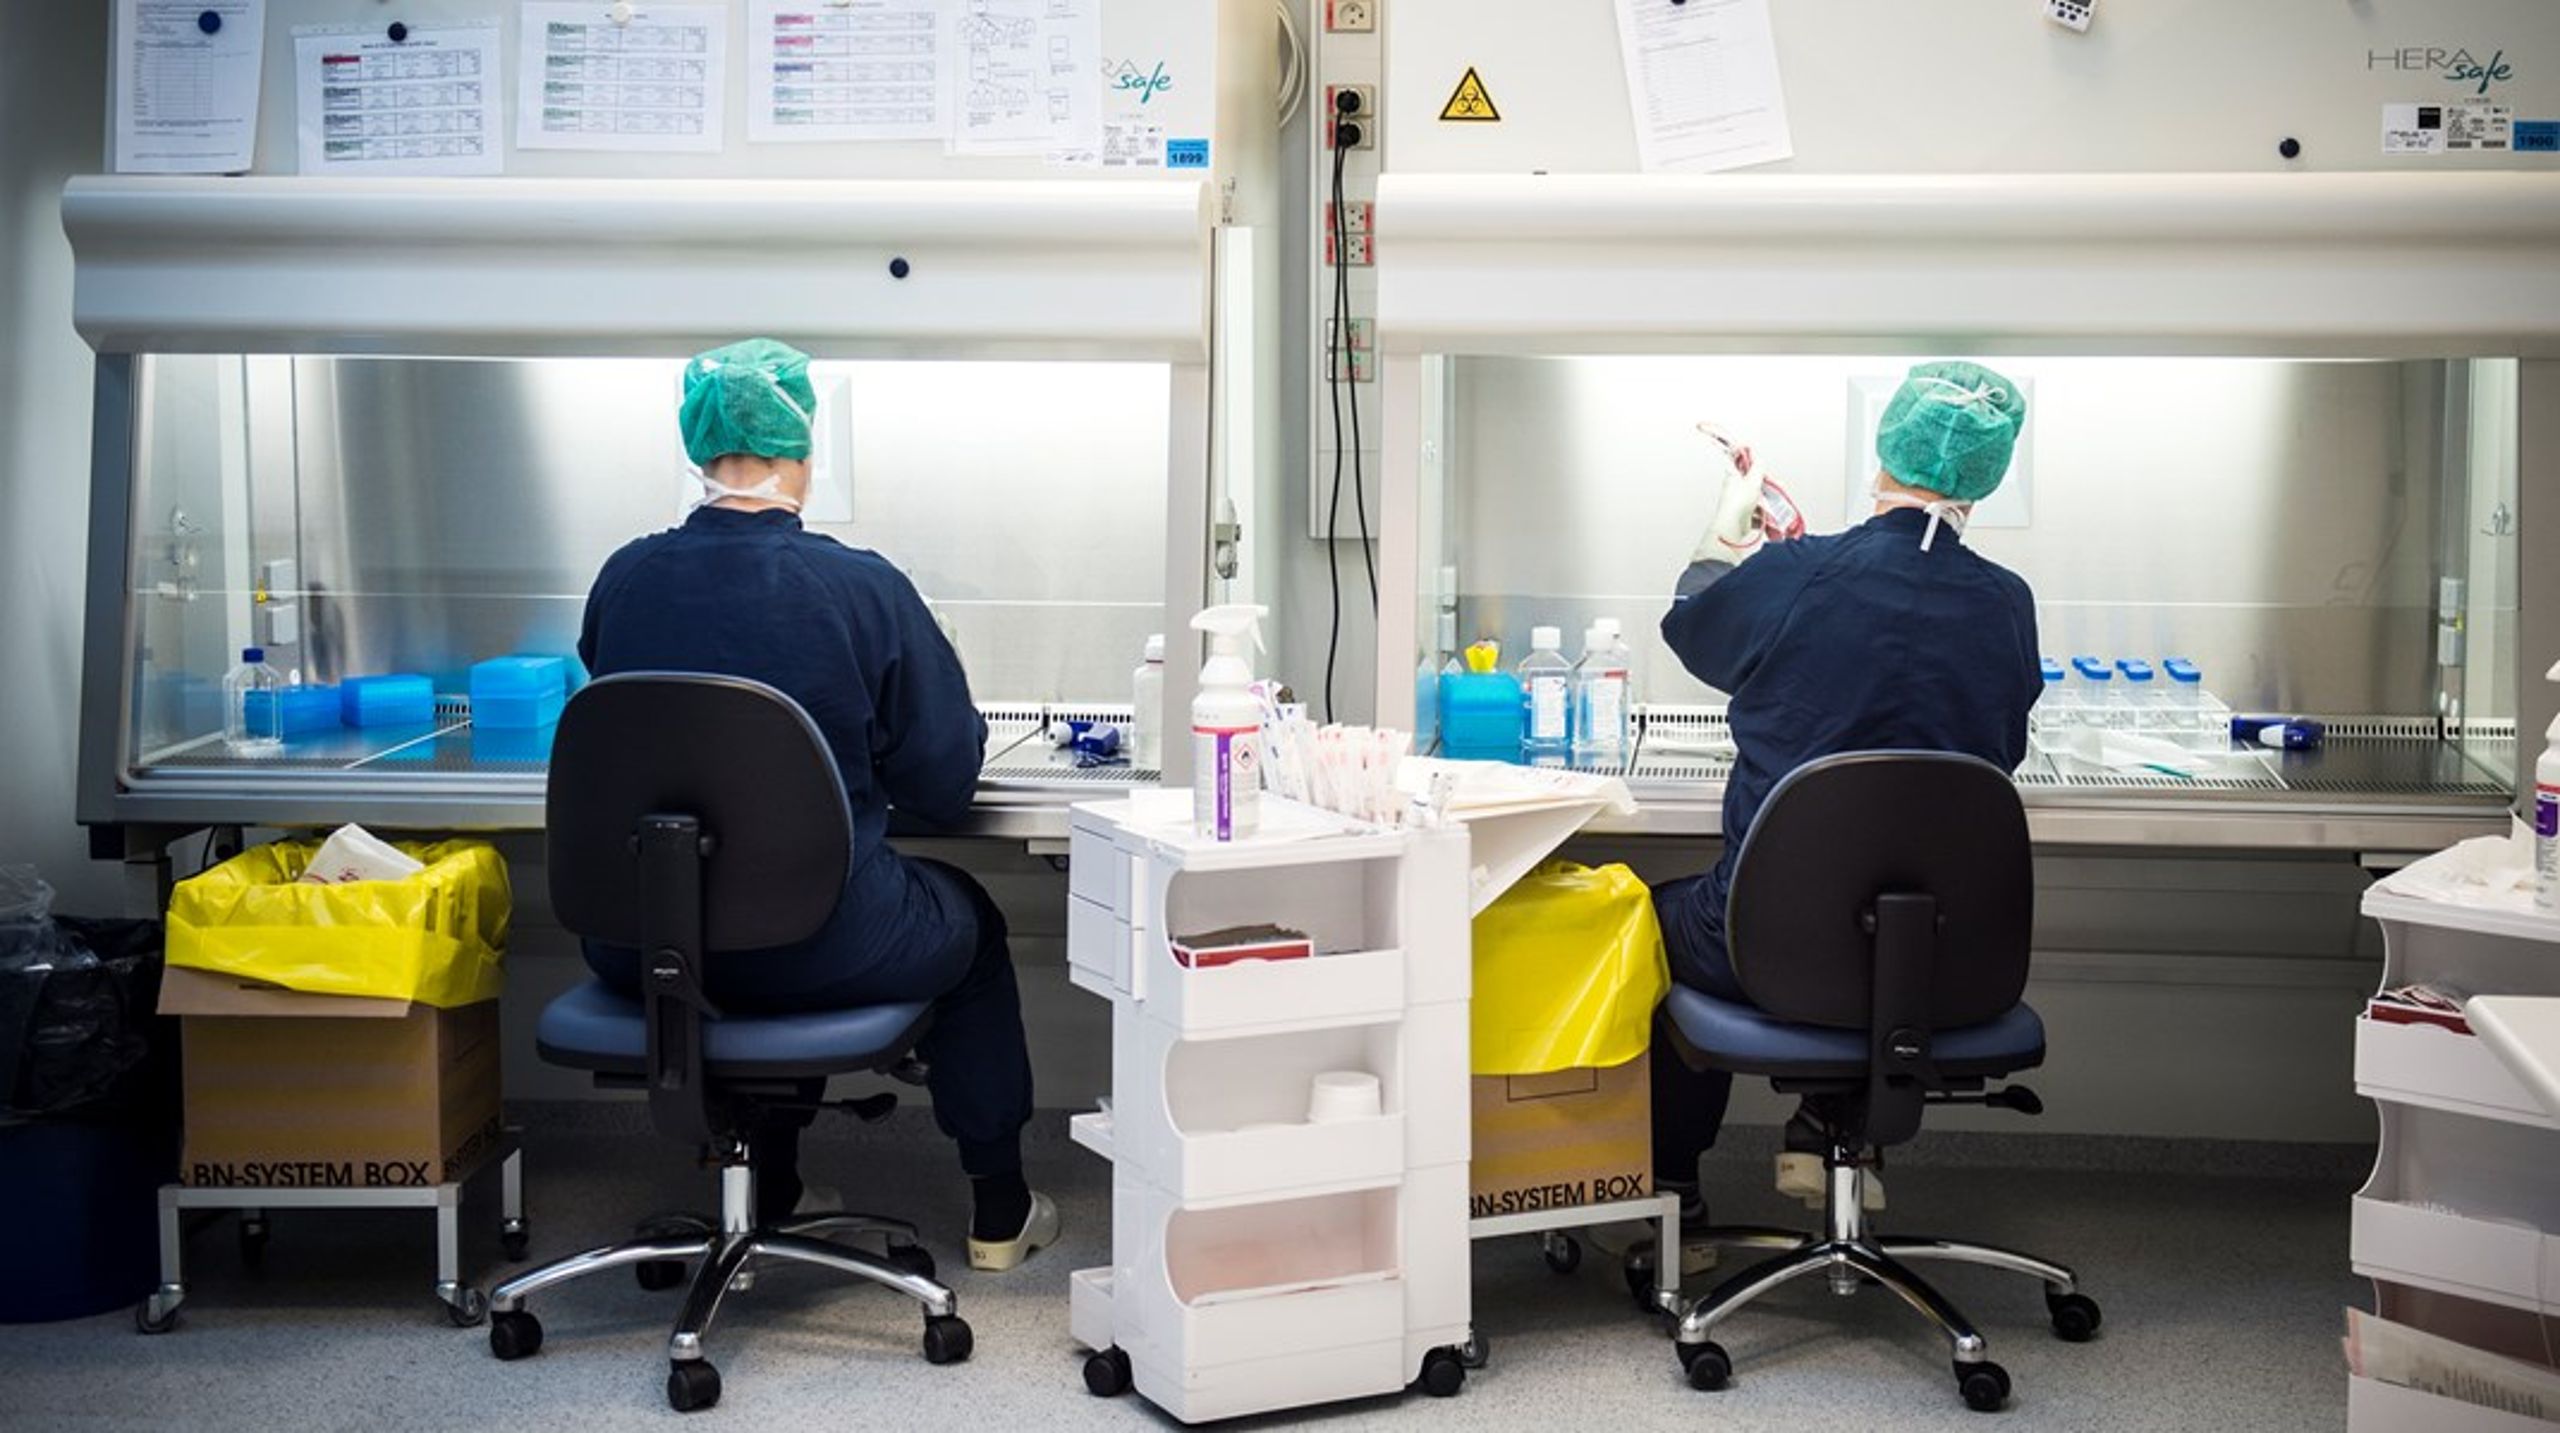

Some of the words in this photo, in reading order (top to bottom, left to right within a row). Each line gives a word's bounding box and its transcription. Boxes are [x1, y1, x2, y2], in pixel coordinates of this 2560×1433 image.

[1111, 61, 1173, 103] safe
[2368, 49, 2477, 70] HERA
[2444, 50, 2513, 94] safe
[2519, 135, 2554, 147] 1900
[1171, 152, 1204, 164] 1899
[193, 1162, 353, 1186] BN-SYSTEM
[365, 1162, 430, 1186] BOX
[1594, 1173, 1644, 1201] BOX
